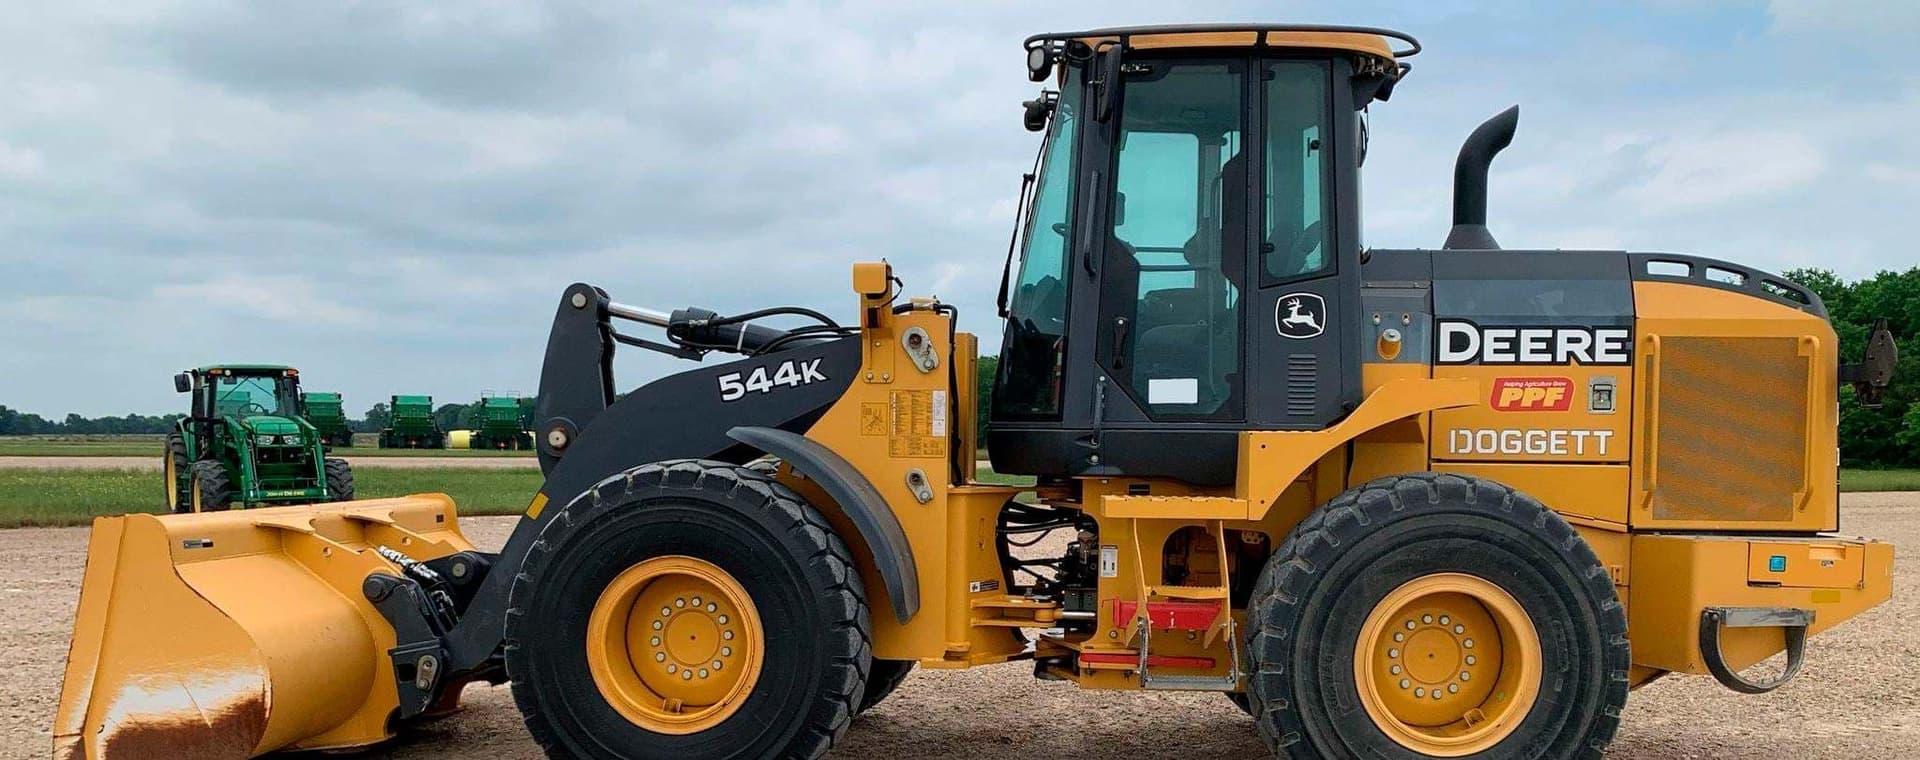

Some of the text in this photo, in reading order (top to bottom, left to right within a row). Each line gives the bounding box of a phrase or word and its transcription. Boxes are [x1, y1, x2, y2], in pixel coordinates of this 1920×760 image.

[1439, 322, 1629, 362] DEERE
[718, 358, 827, 401] 544K
[1498, 387, 1566, 407] PPF
[1449, 429, 1613, 455] DOGGETT
